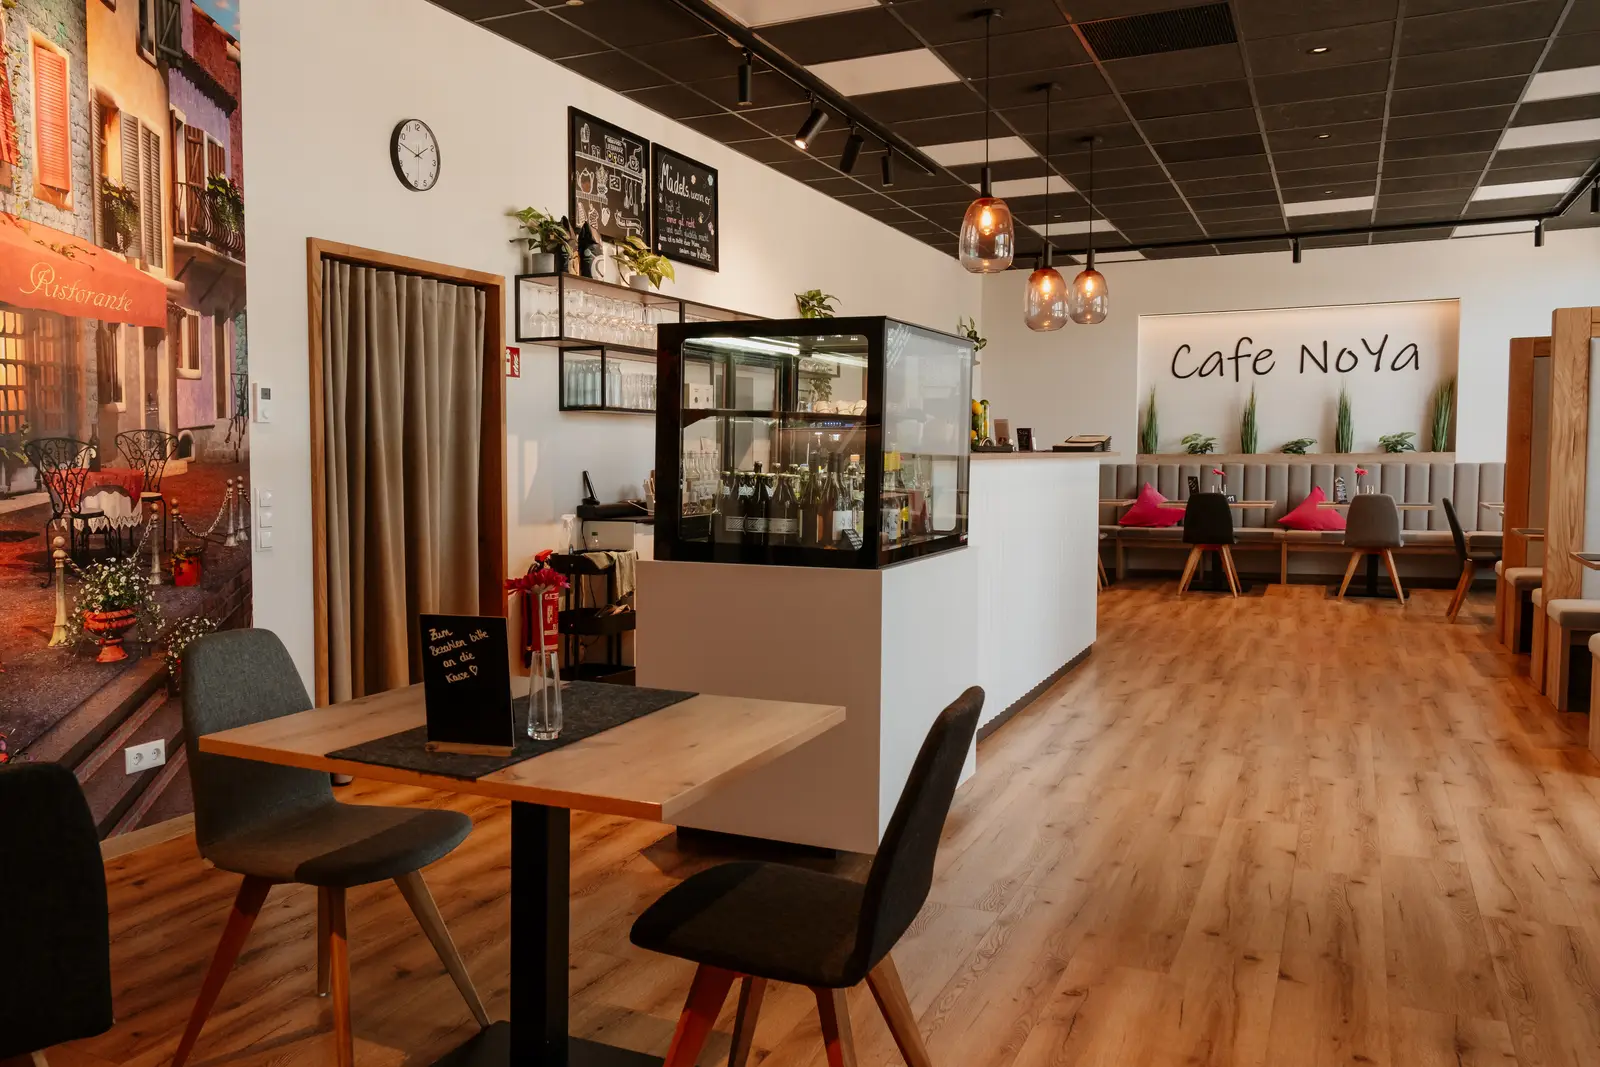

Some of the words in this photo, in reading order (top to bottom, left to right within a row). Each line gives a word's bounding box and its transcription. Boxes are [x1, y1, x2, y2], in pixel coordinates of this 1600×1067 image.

[414, 123, 421, 132] 12
[430, 144, 434, 152] 2
[660, 162, 690, 198] Mädels,
[690, 190, 704, 202] wenn
[704, 196, 710, 206] er
[18, 262, 134, 312] Ristorante
[1171, 336, 1276, 382] Cafe
[1299, 334, 1420, 374] NoYa
[428, 628, 453, 641] Zum
[428, 640, 468, 656] Bezahlen
[469, 628, 490, 642] bitte
[442, 658, 456, 668] an
[459, 651, 476, 662] die
[445, 671, 470, 684] Kasse
